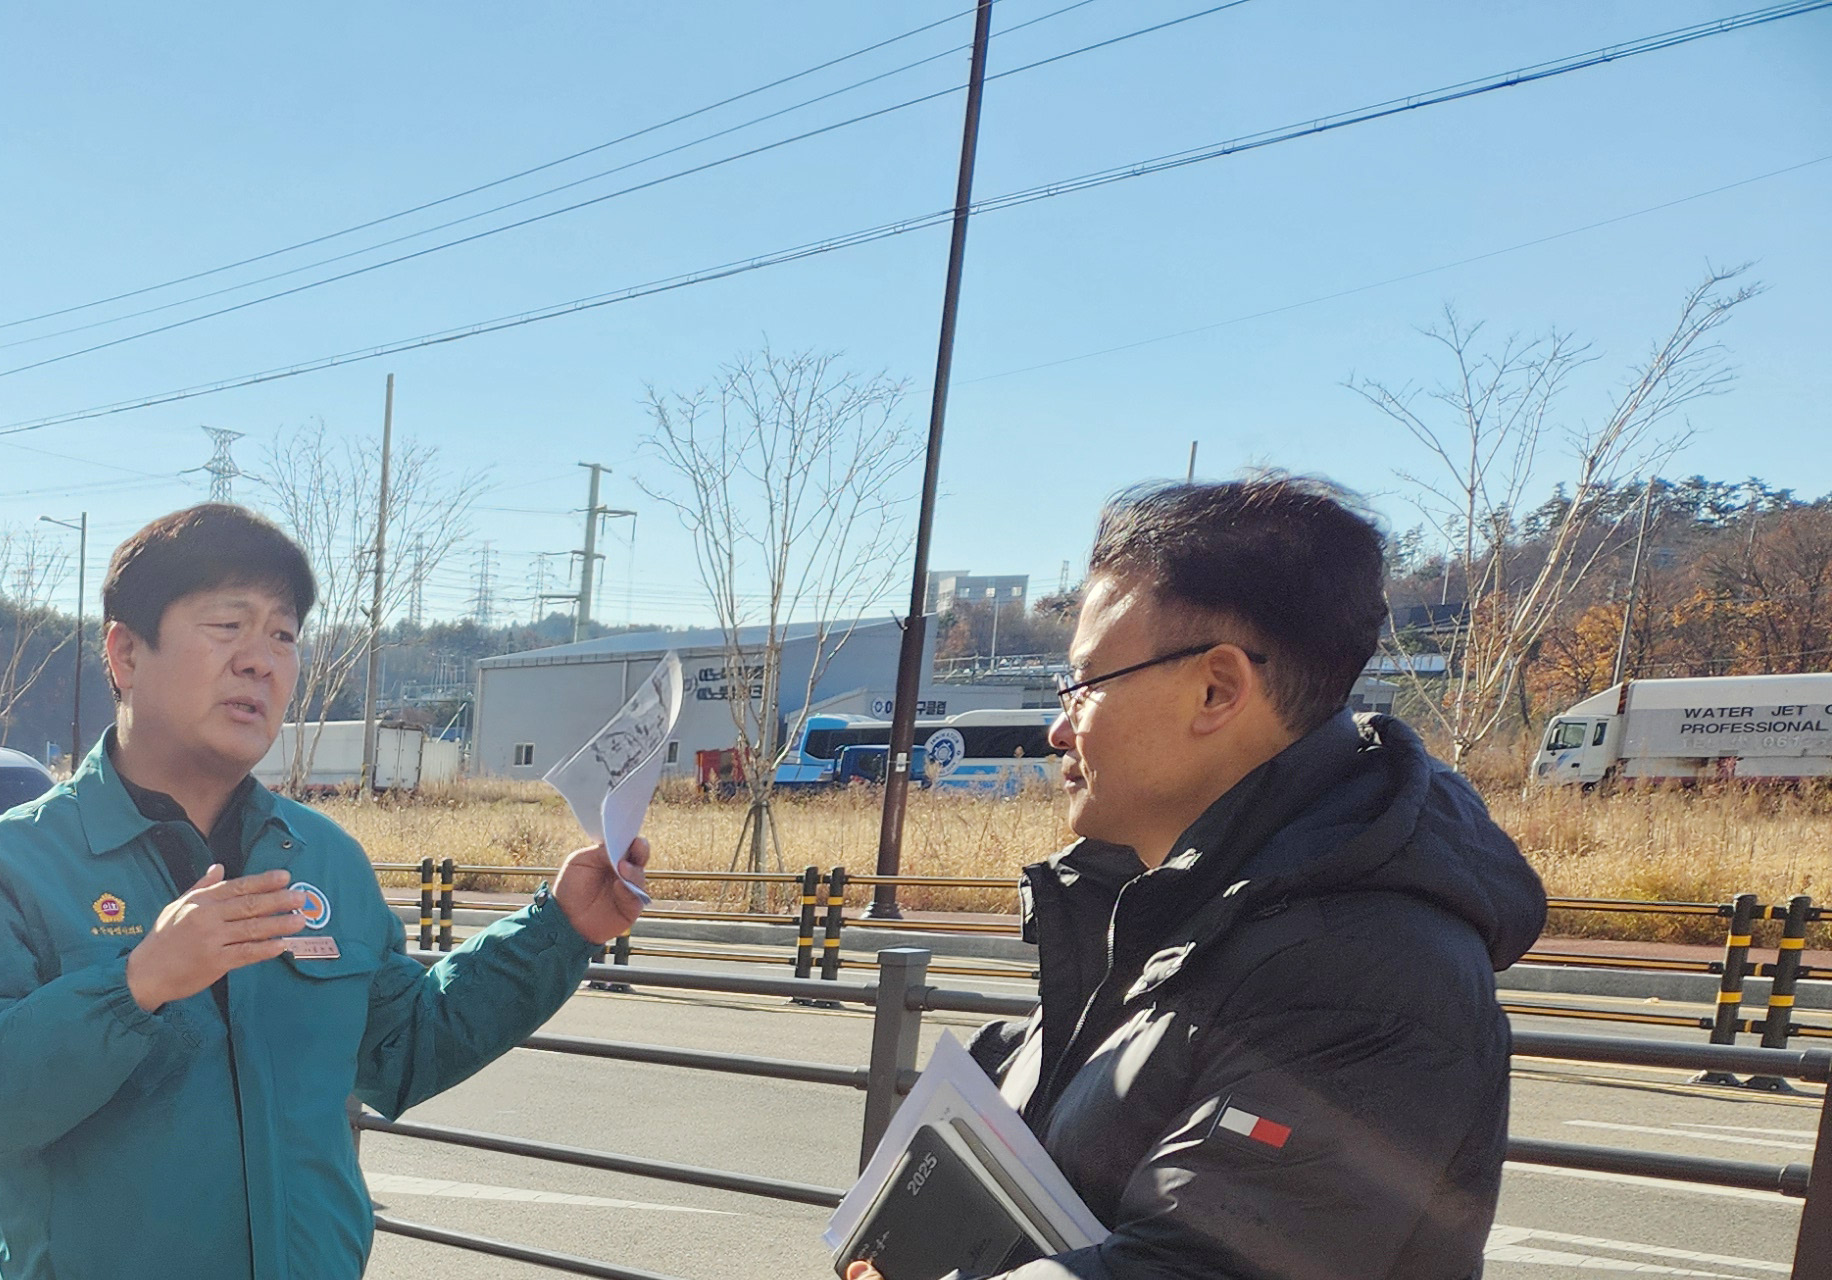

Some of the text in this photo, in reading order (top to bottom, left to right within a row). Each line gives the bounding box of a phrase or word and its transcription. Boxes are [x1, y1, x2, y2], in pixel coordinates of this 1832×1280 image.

[1684, 705, 1808, 719] WATER JET
[1680, 720, 1829, 734] PROFESSIONAL
[907, 1151, 939, 1196] 2025
